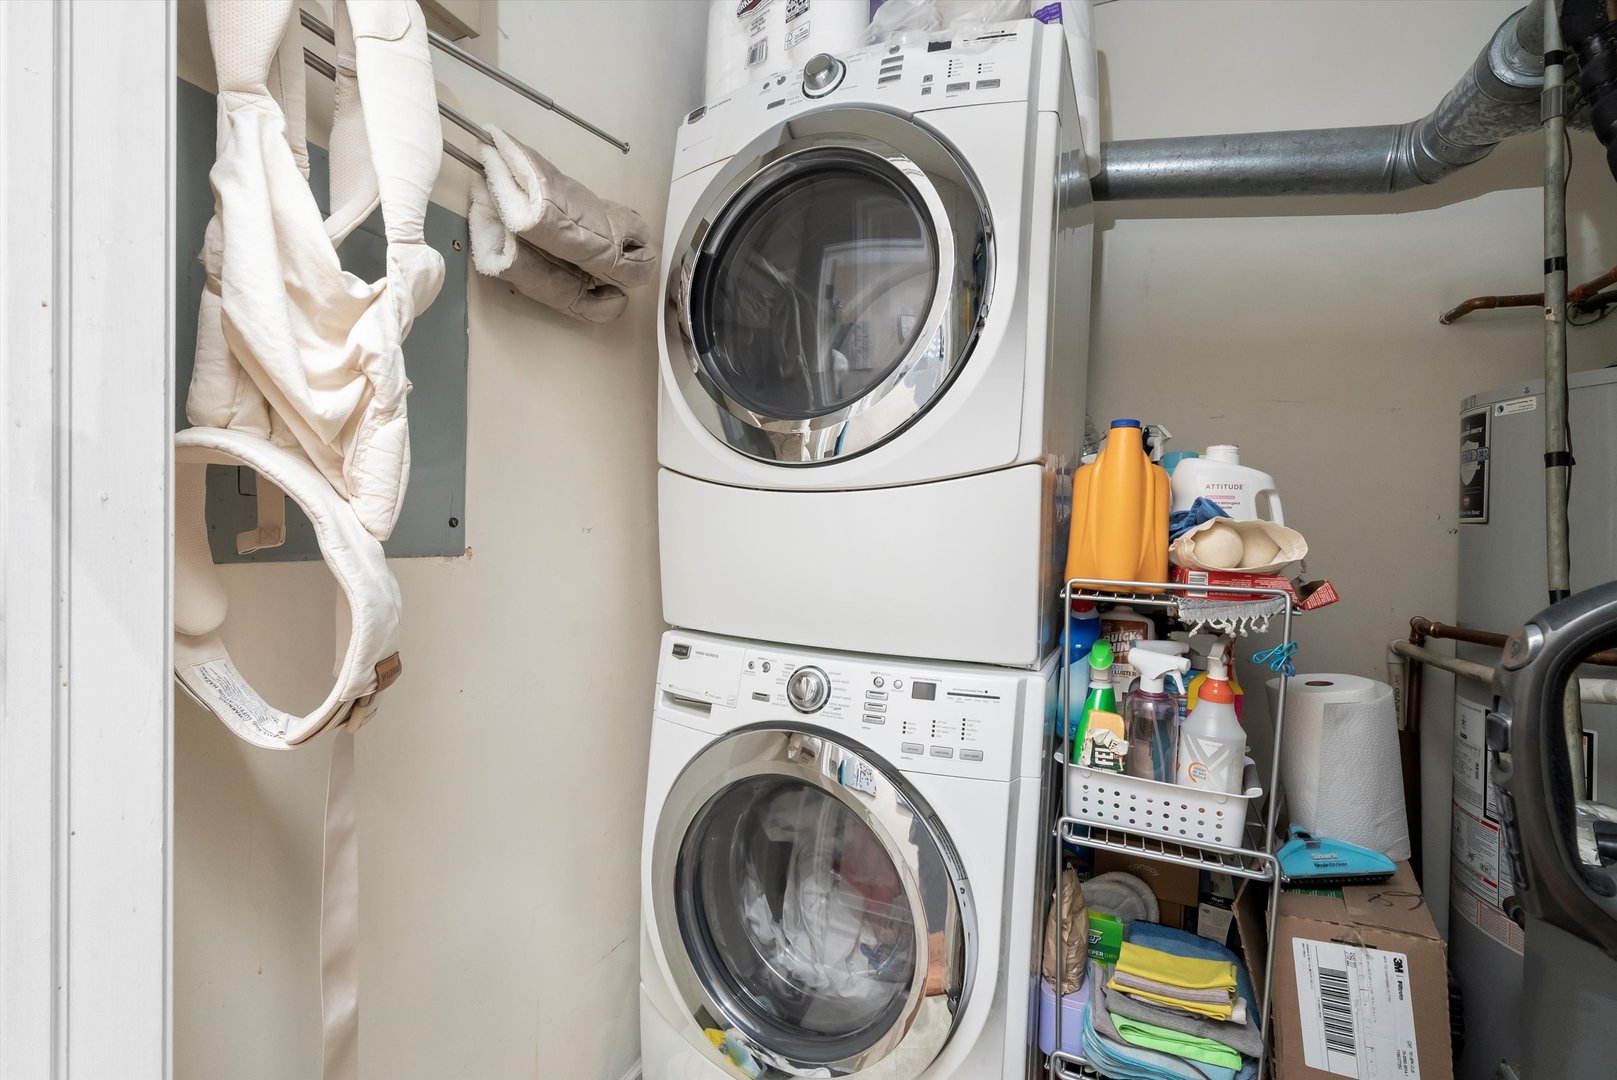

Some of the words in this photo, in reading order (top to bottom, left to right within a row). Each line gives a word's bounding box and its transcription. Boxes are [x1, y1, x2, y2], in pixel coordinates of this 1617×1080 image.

[1104, 631, 1138, 642] QUICK
[1110, 641, 1130, 652] HIN
[1128, 863, 1160, 878] canopy
[1393, 957, 1403, 974] 3M
